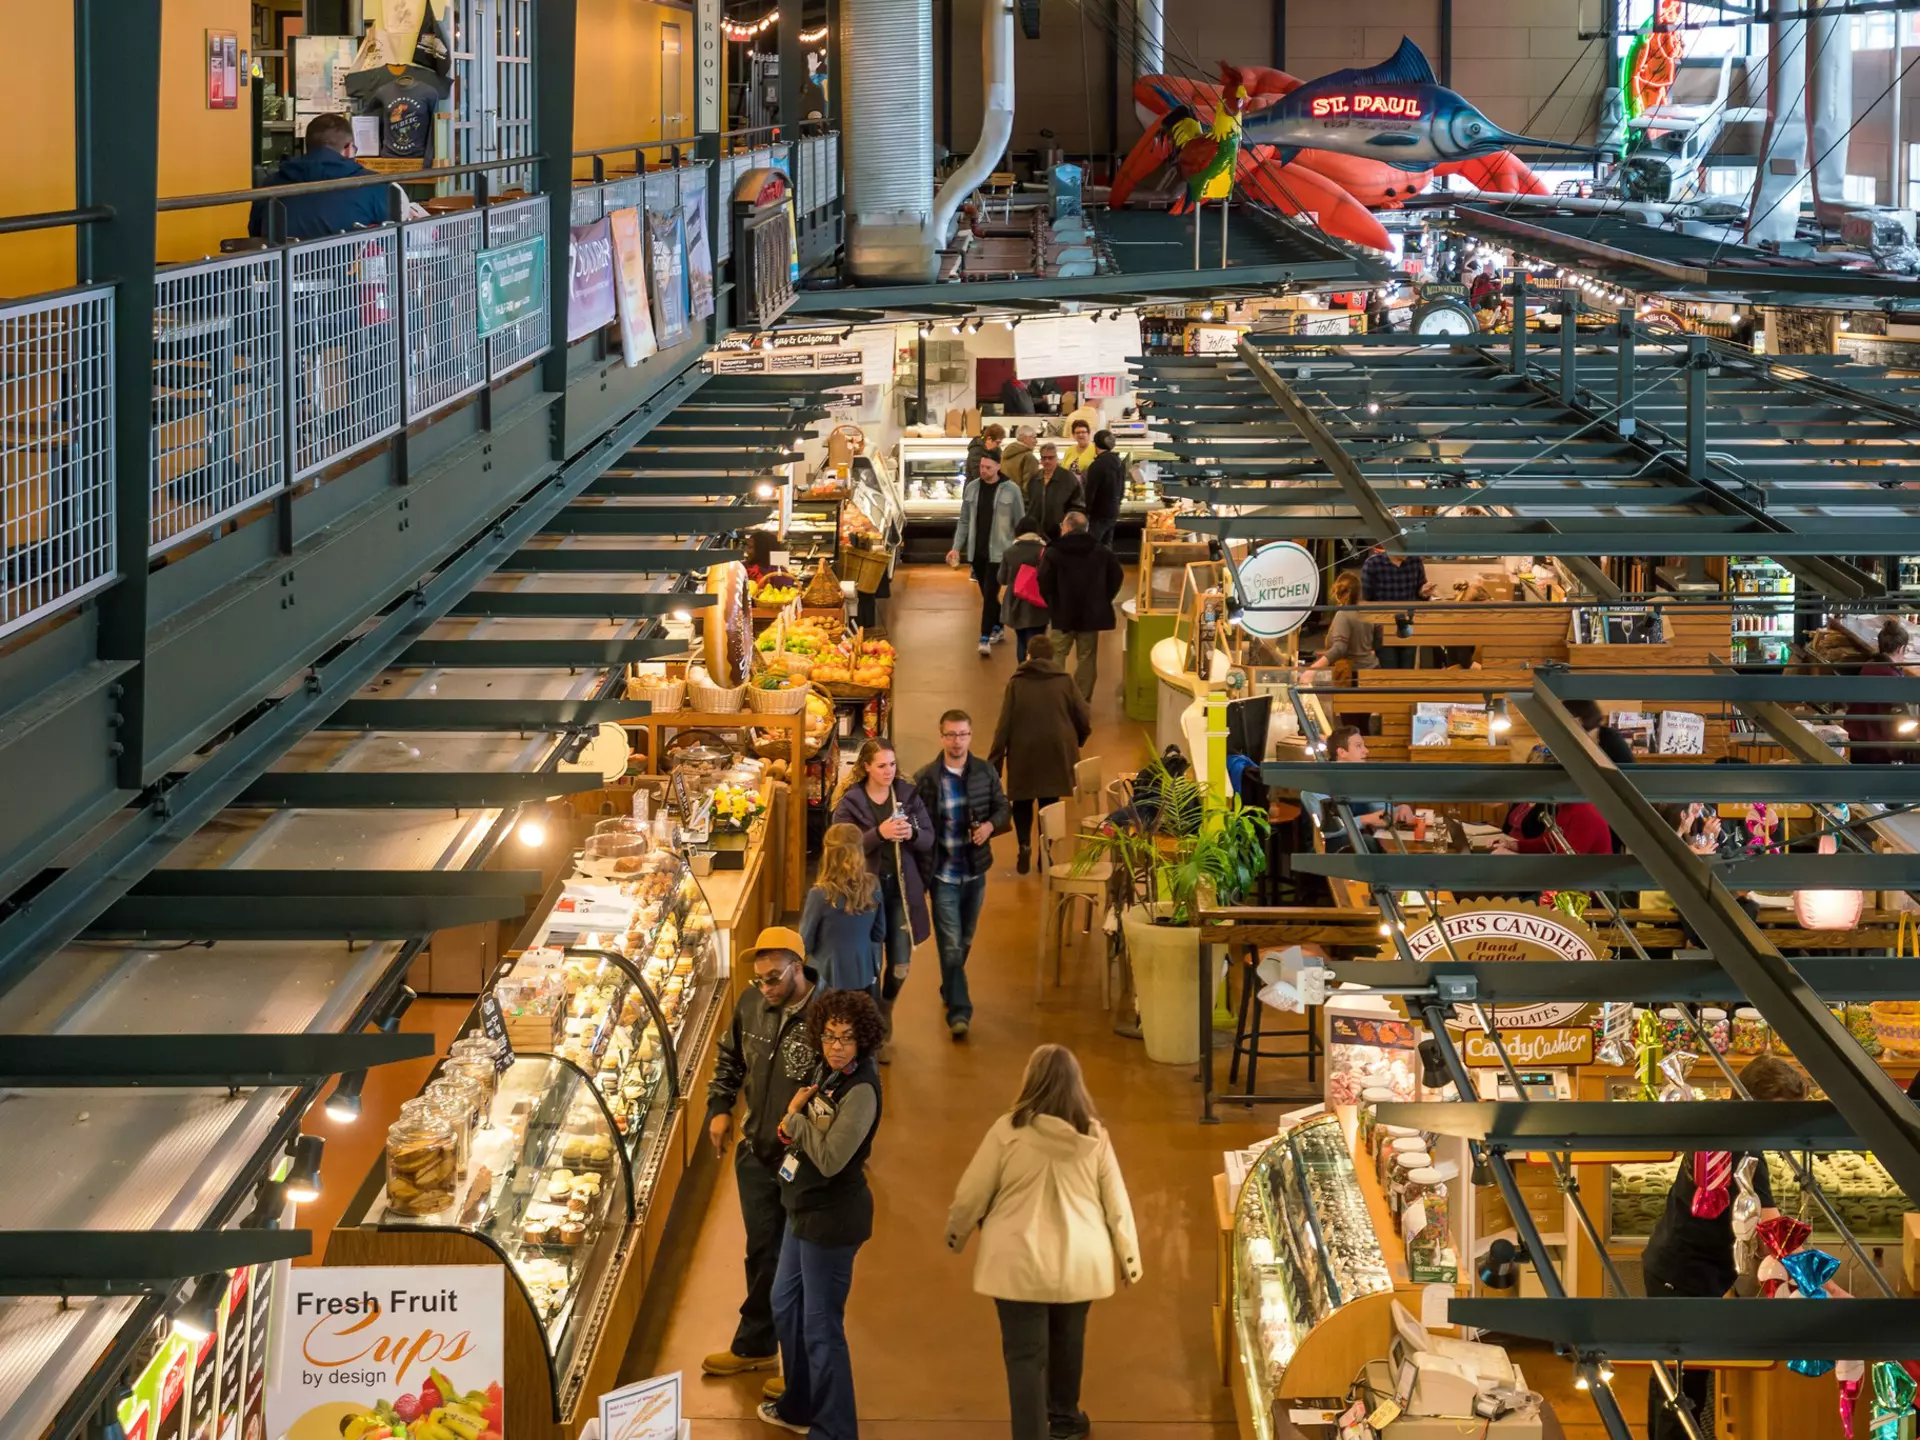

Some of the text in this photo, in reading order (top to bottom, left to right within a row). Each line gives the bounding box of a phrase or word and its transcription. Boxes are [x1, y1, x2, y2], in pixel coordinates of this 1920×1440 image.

[1312, 95, 1422, 117] ST. PAUL
[390, 116, 418, 130] PUBLIC
[1404, 260, 1423, 274] EXIT
[1426, 285, 1466, 296] MILWAUKEE
[797, 334, 835, 346] Calzones
[1090, 376, 1117, 397] EXIT
[1253, 574, 1284, 588] Green
[1258, 582, 1311, 601] KITCHEN
[1409, 916, 1588, 961] KEHR'S CANDIES
[1475, 941, 1519, 953] Hand
[1467, 951, 1526, 961] Crafted
[1533, 1029, 1586, 1060] Cashier
[297, 1289, 458, 1315] Fresh Fruit
[303, 1300, 477, 1387] Cups
[302, 1369, 387, 1388] by design
